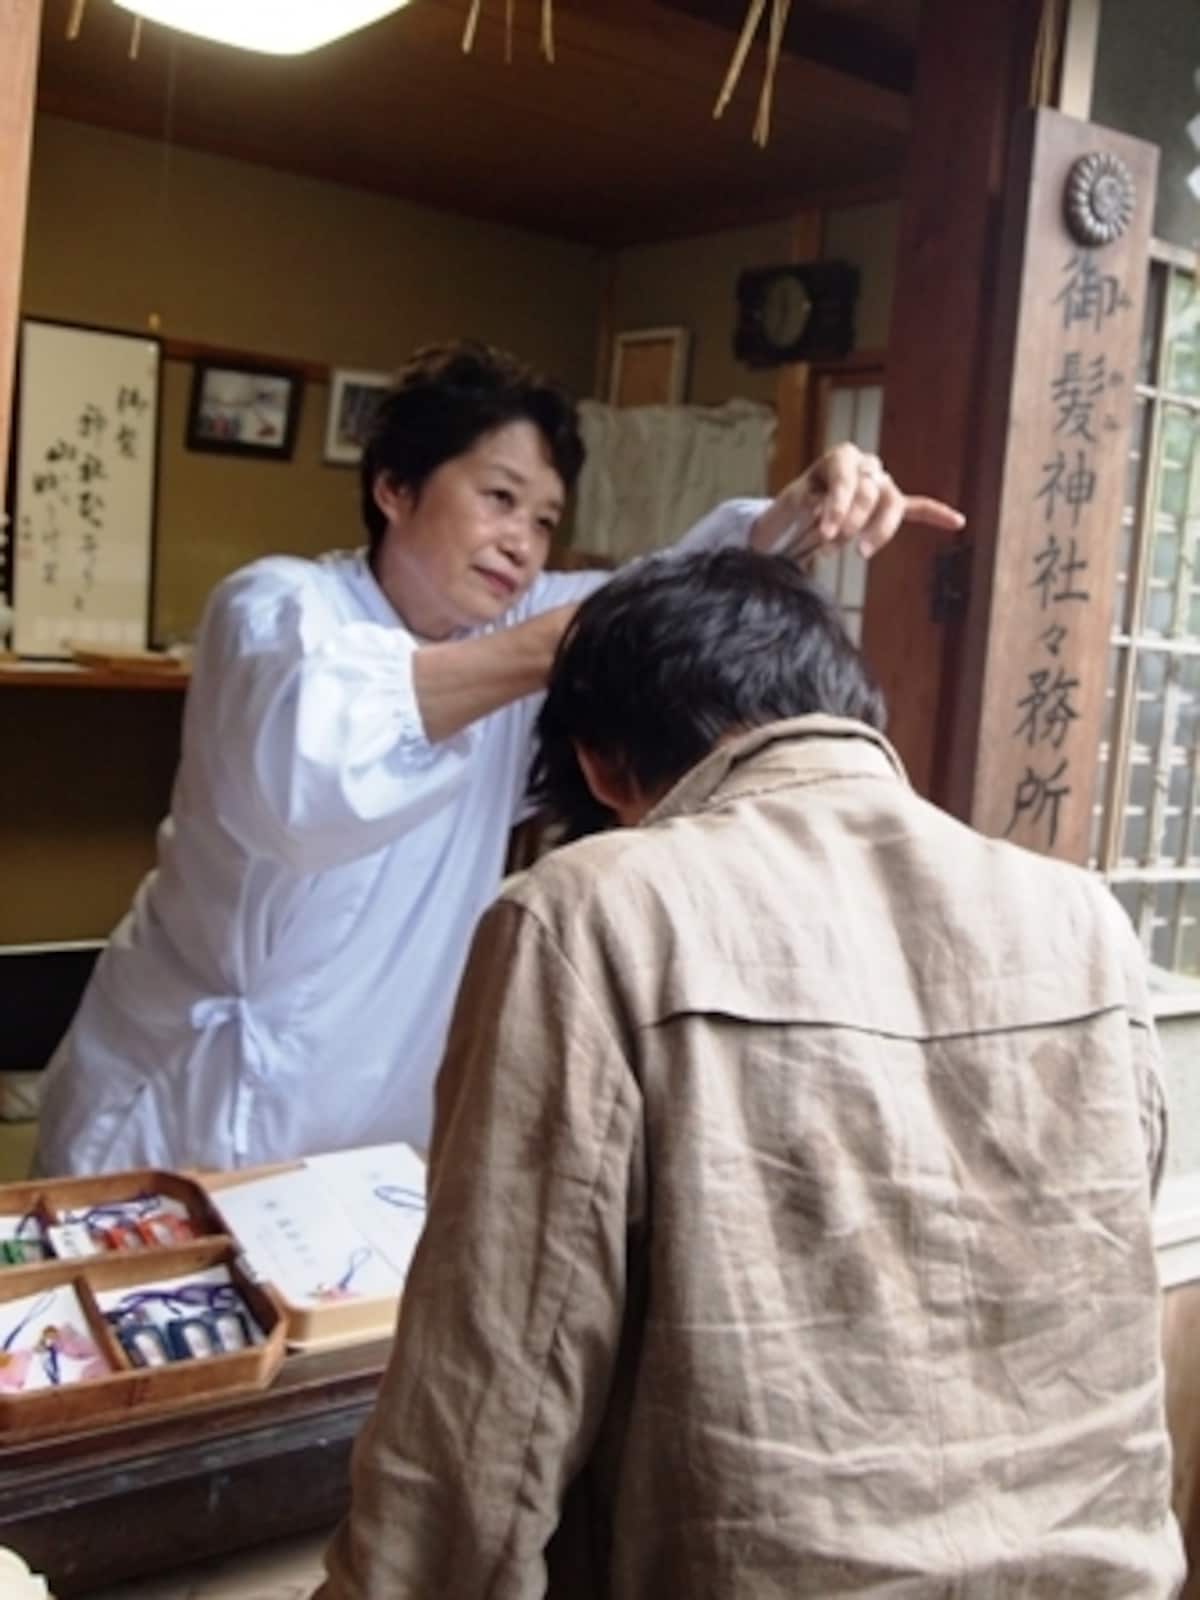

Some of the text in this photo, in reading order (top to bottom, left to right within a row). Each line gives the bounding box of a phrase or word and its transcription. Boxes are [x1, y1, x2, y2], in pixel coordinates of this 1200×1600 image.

[1003, 251, 1119, 848] 御髪神社々務所
